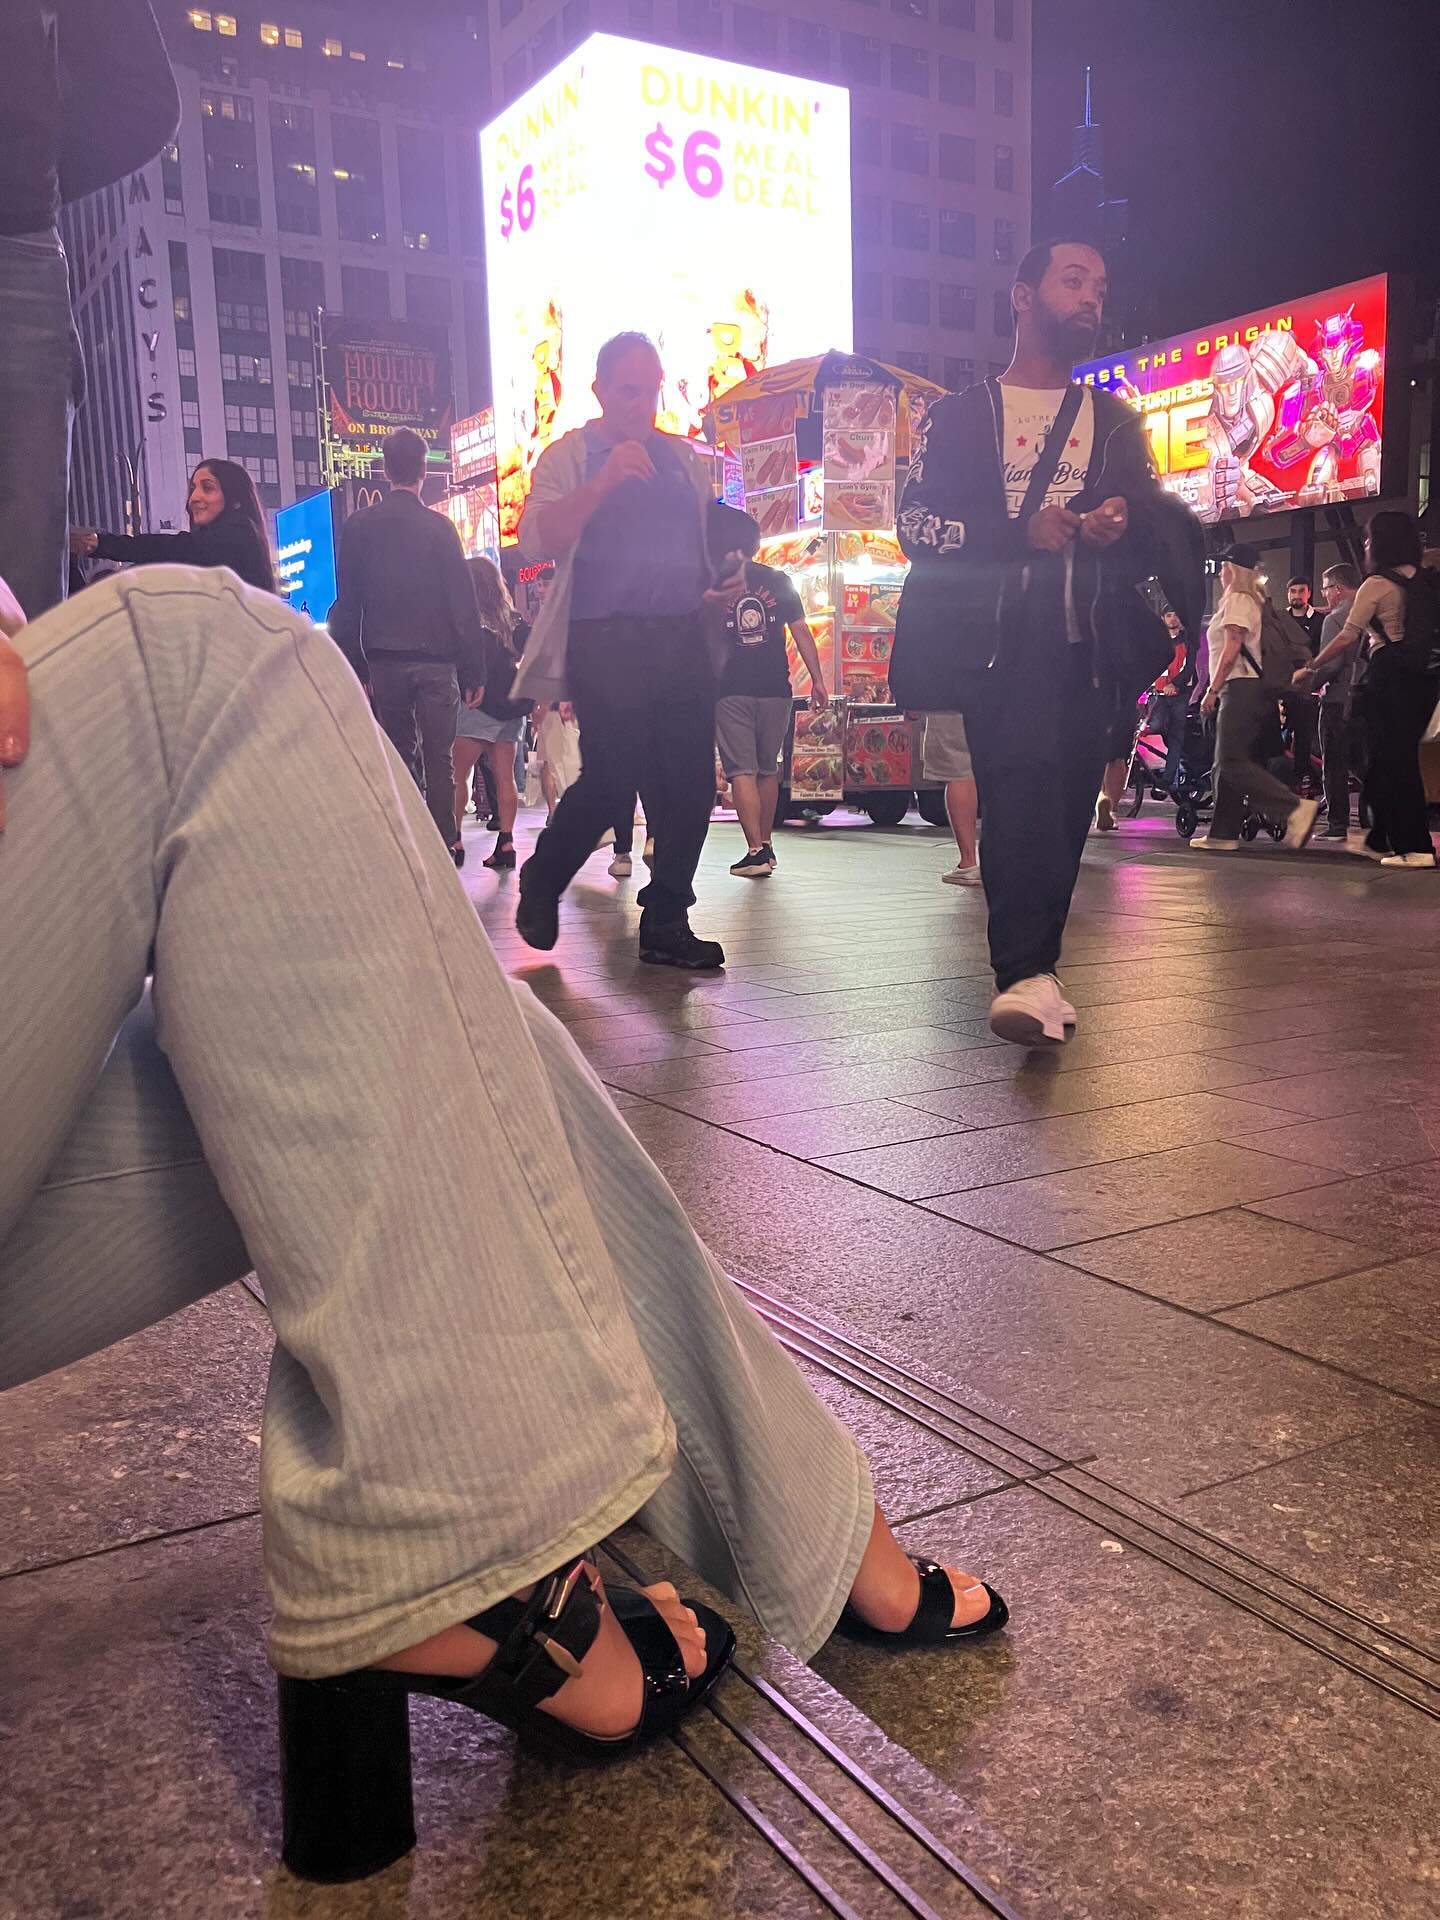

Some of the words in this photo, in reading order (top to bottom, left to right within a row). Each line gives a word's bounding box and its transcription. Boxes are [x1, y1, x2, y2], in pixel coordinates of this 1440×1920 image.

[640, 64, 820, 136] DUNKIN'
[645, 121, 723, 198] $6
[734, 140, 819, 180] MEAL
[500, 164, 535, 243] $6
[733, 173, 820, 215] DEAL
[1138, 348, 1182, 372] THE
[1196, 316, 1293, 356] ORIGIN
[347, 423, 366, 434] ON
[369, 425, 439, 439] BROWAY
